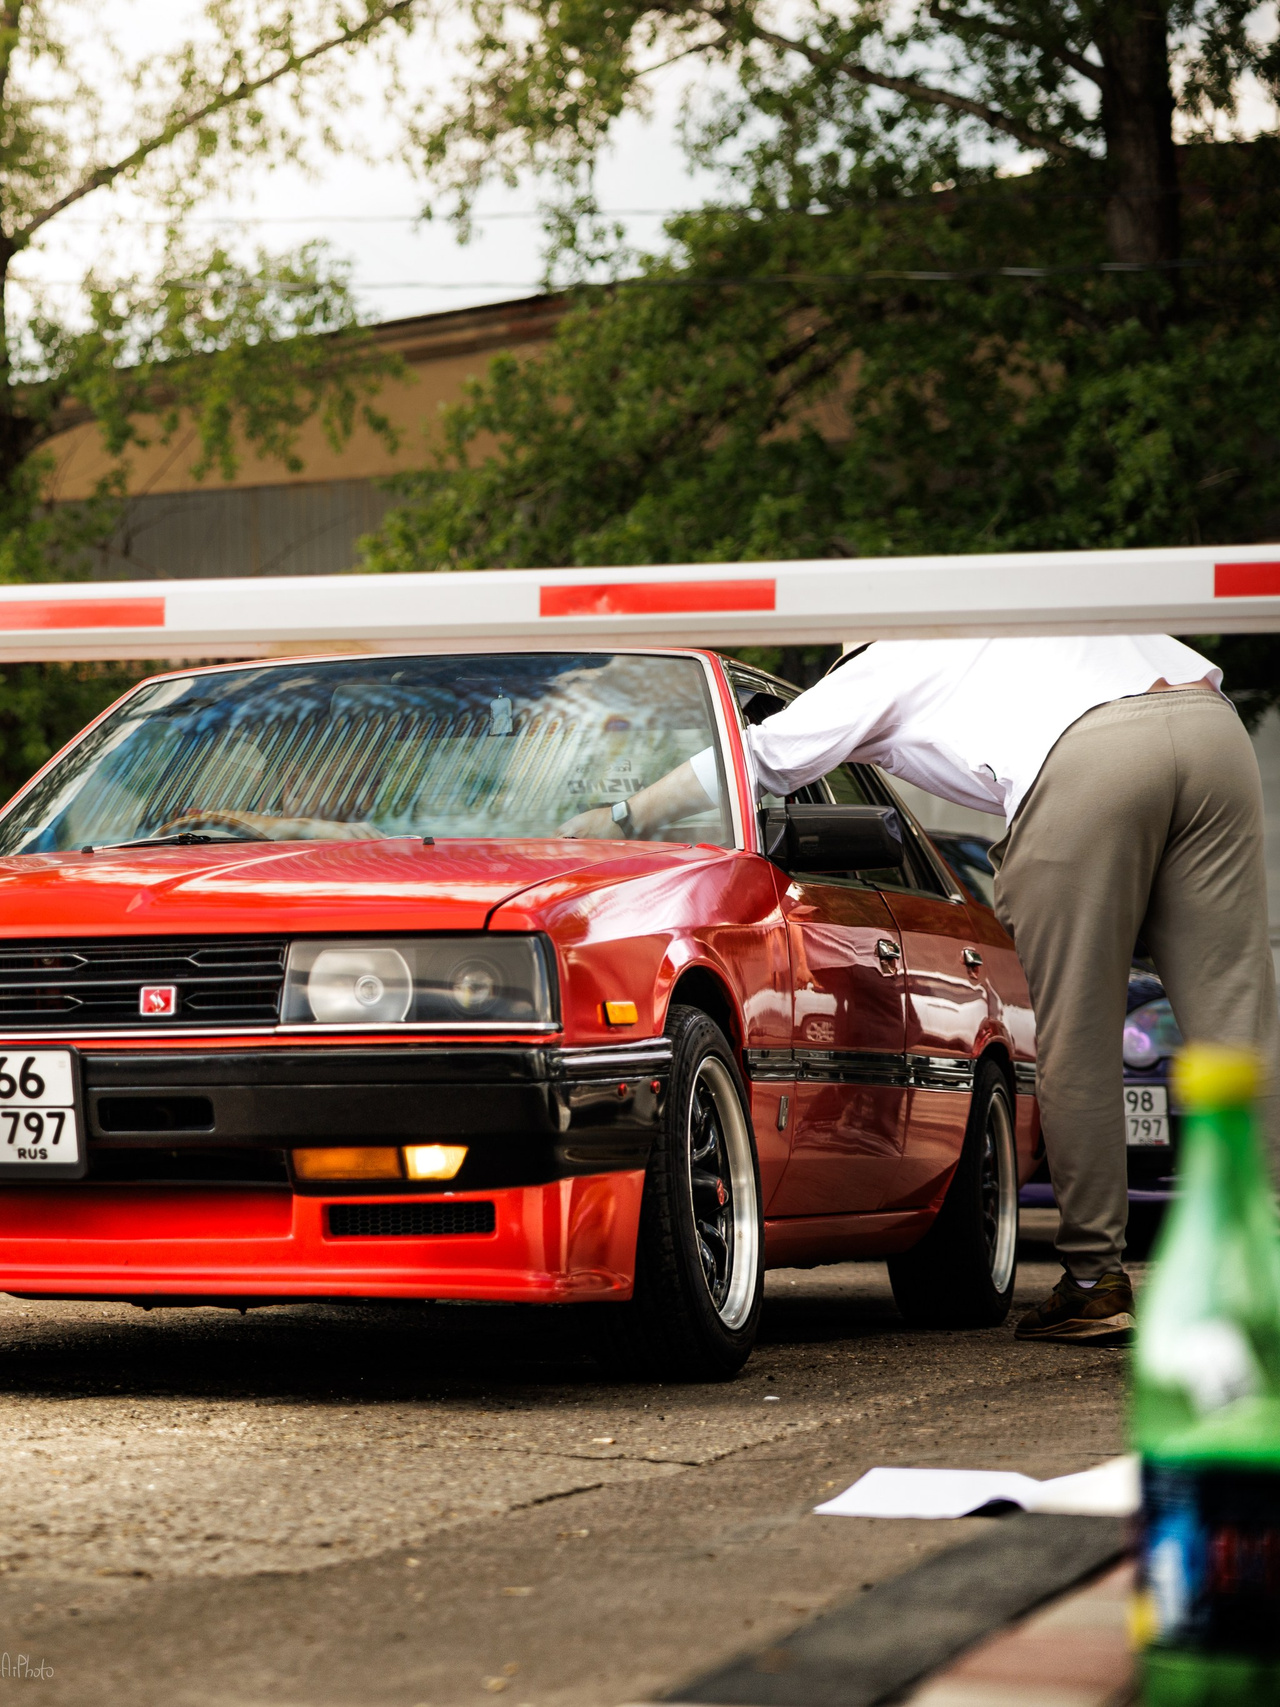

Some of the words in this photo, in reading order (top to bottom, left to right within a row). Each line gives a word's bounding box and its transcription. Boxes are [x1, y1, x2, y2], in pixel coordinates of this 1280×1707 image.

[1126, 1090, 1154, 1112] 98
[1, 1111, 66, 1146] 797
[1130, 1118, 1162, 1136] 797
[18, 1148, 48, 1160] RUS
